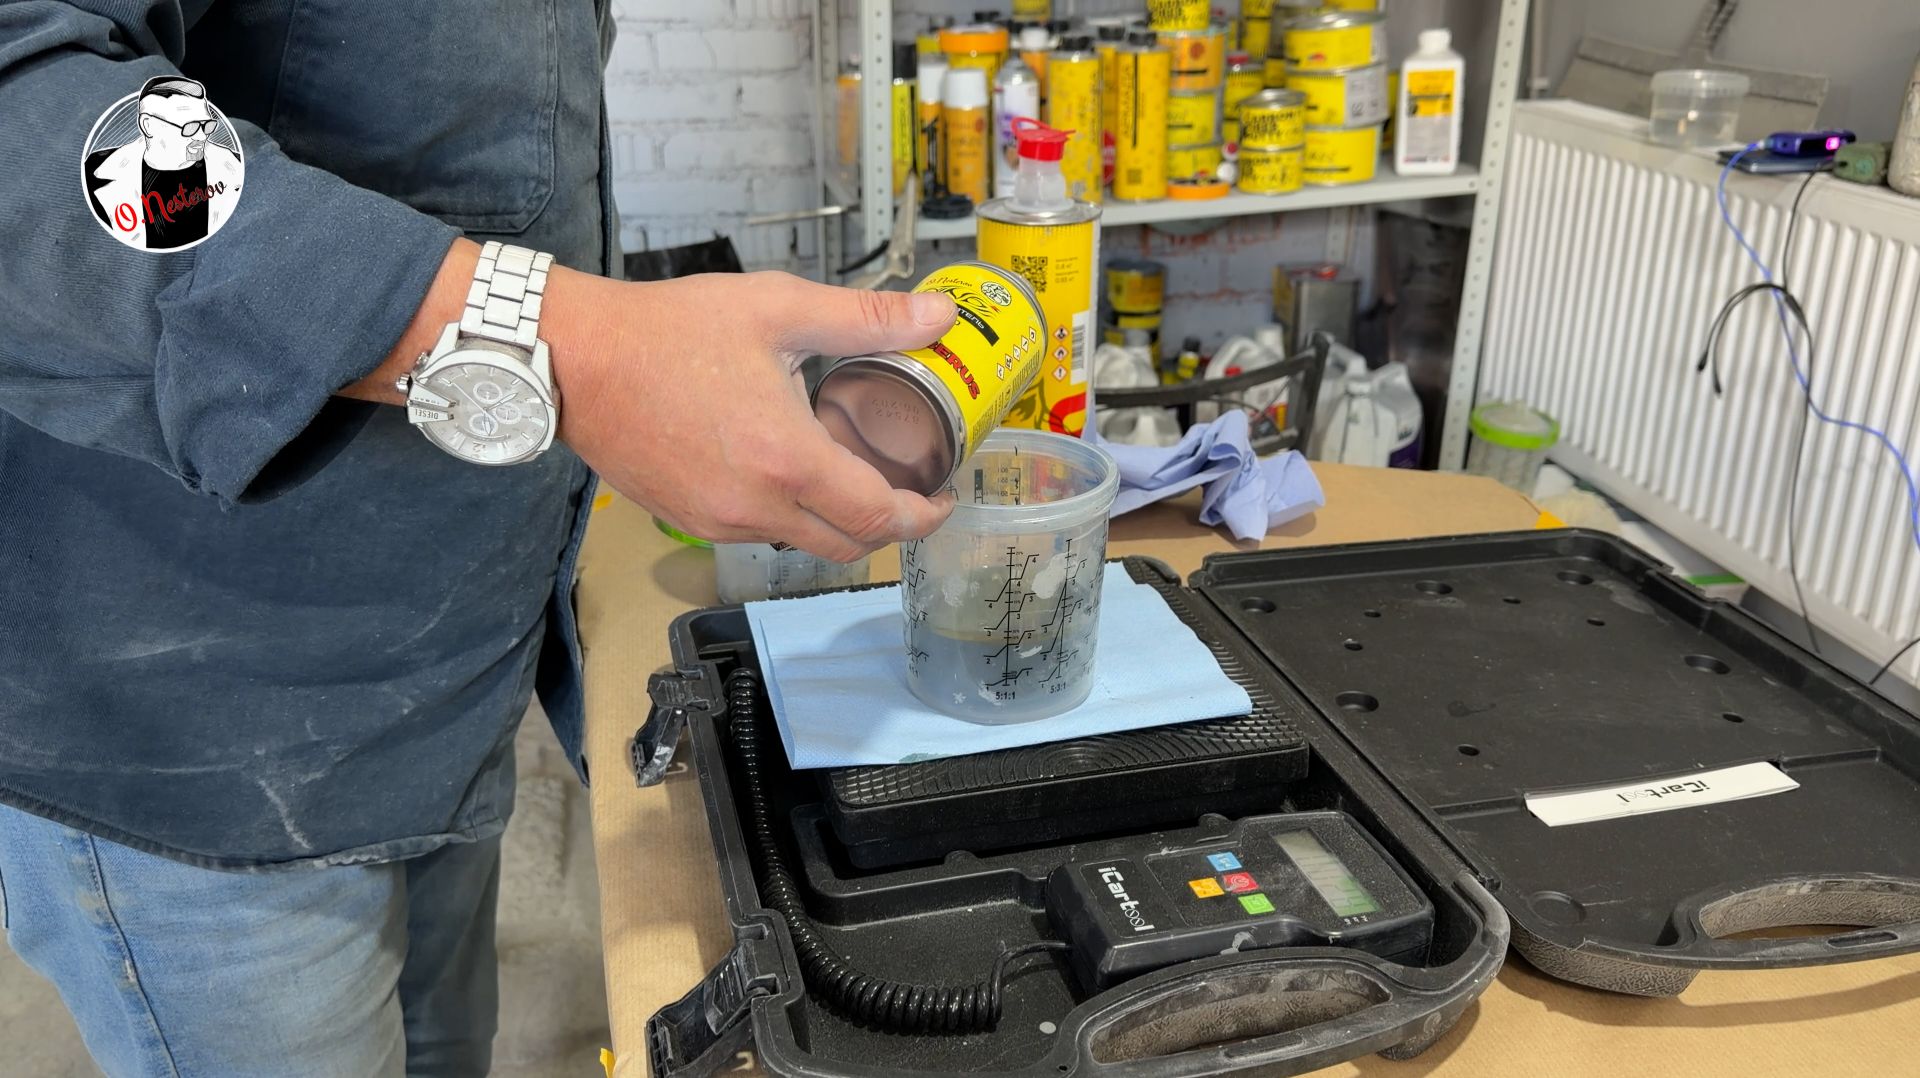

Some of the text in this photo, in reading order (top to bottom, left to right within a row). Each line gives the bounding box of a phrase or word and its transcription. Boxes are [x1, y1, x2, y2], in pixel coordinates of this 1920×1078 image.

[958, 307, 985, 329] ТЕЛЬ
[415, 408, 439, 420] DIESEL
[995, 691, 1016, 701] 5:1:1
[1098, 866, 1155, 932] iCartool
